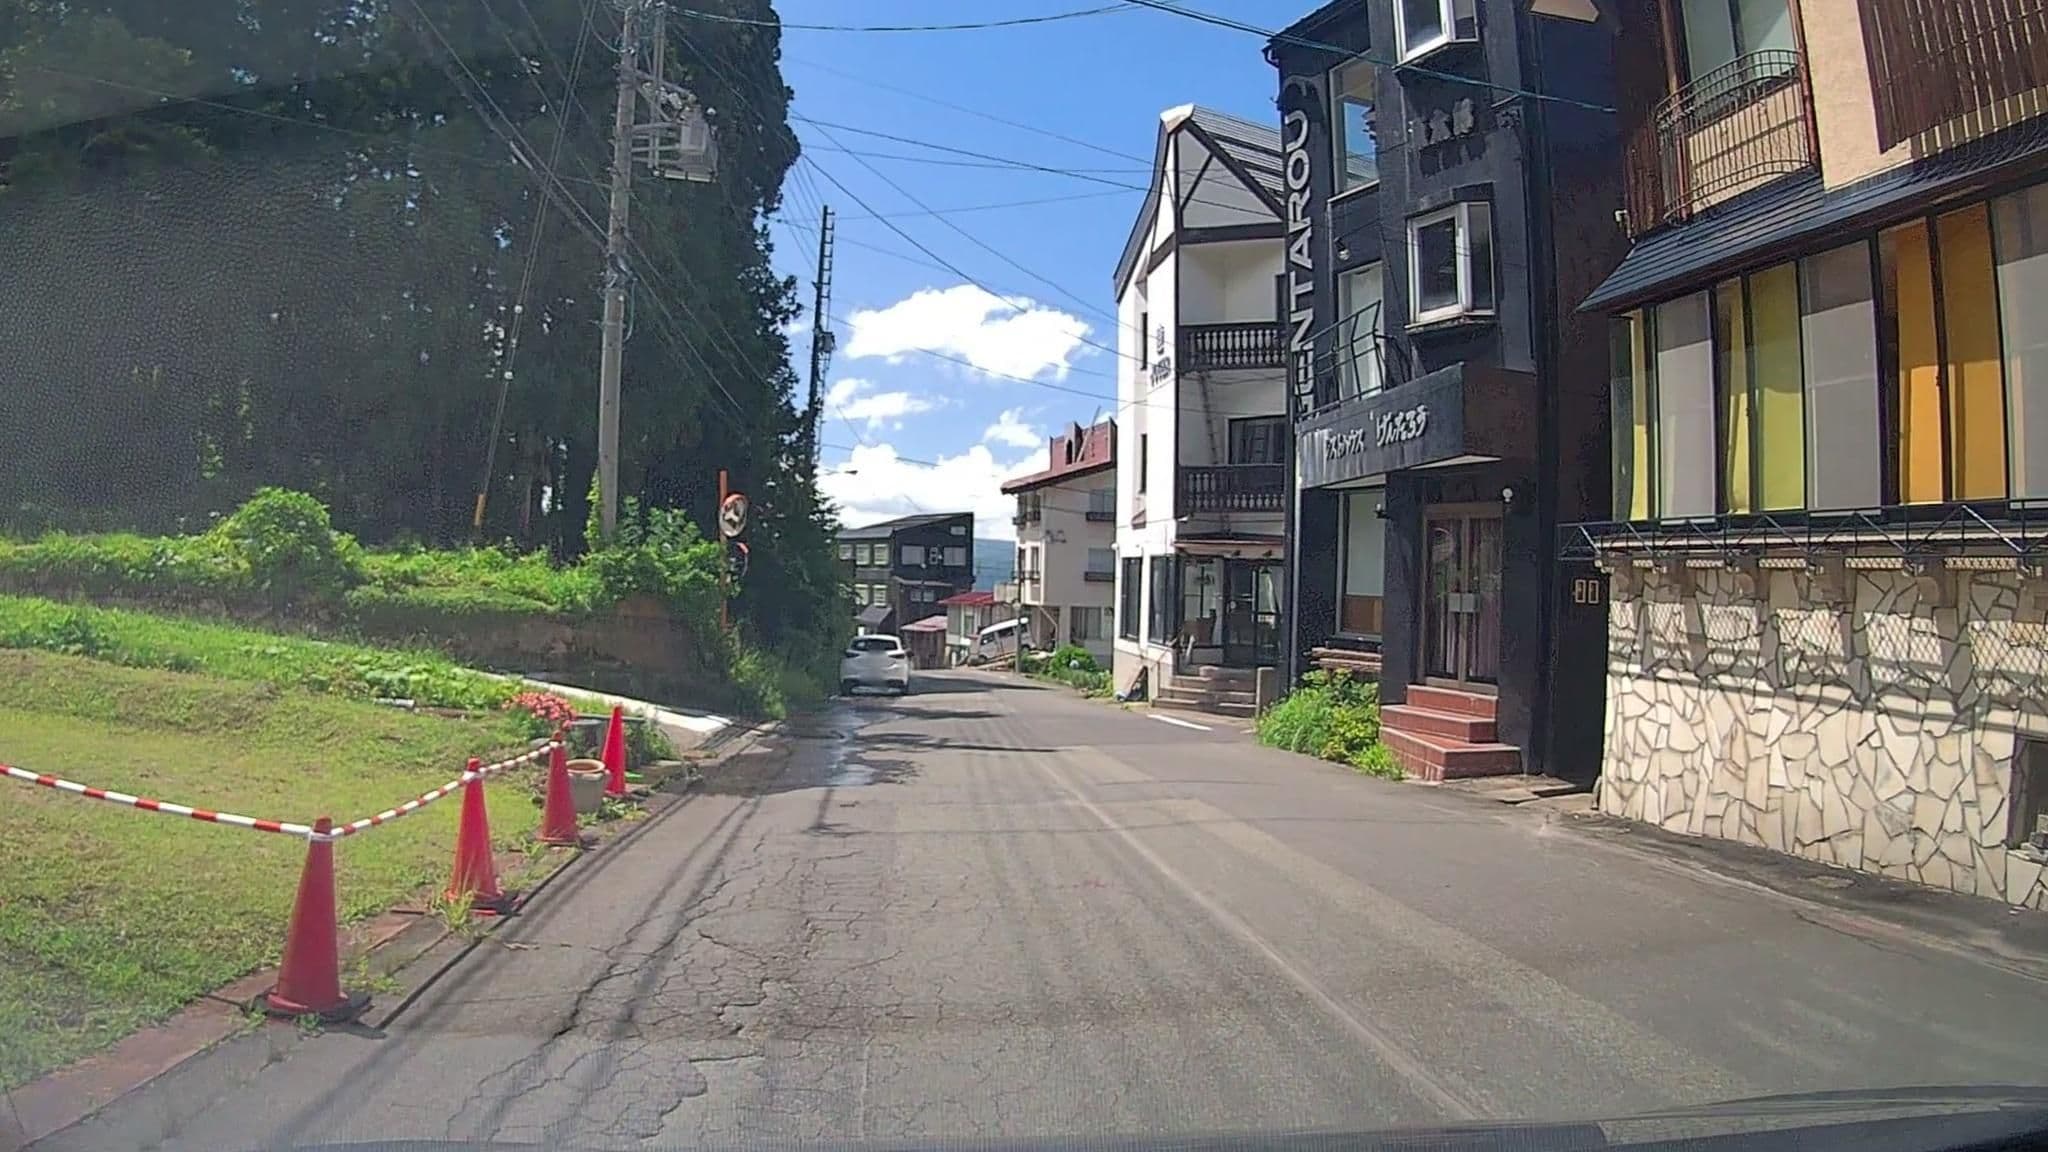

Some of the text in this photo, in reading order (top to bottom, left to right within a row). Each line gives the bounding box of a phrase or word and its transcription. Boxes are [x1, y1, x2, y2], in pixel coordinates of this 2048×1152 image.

[1376, 405, 1428, 446] げんたろう
